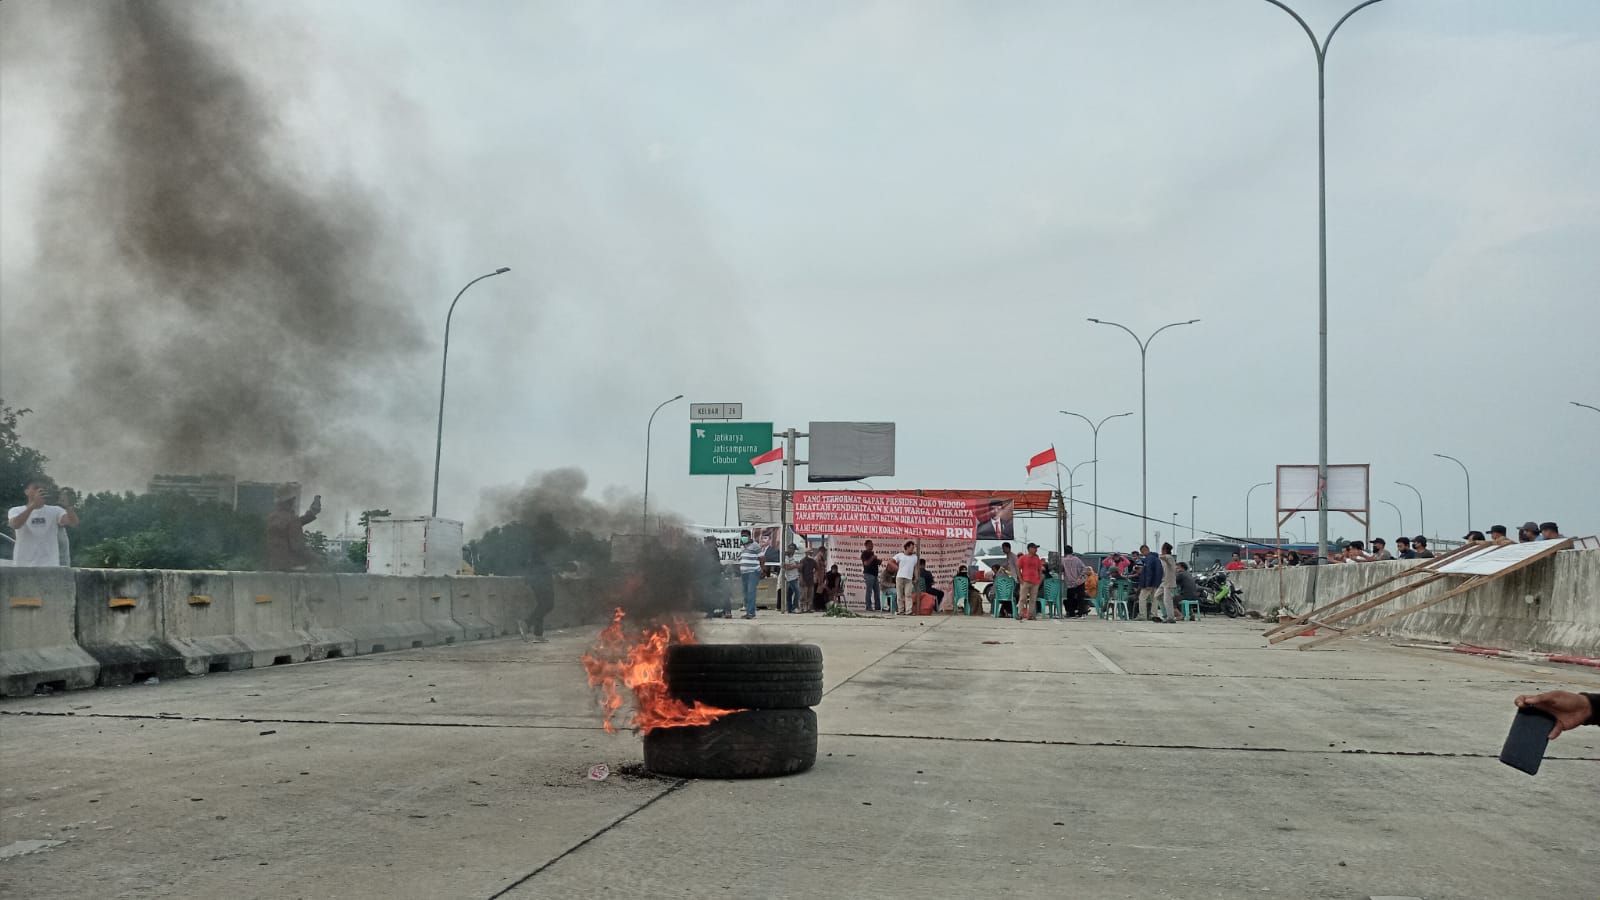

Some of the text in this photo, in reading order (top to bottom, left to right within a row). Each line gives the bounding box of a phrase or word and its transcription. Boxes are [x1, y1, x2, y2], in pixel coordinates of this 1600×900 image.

[713, 434, 743, 443] Jatikarya
[712, 445, 758, 454] Jatisampurna
[712, 456, 737, 464] Cibubur
[803, 495, 966, 509] YANG TERHORMAT BAPAK PRESIDEN JOKO WIDODO
[795, 503, 974, 518] LIHATLAH PENDERITAAN KAMI WARGA JATIKARYA
[795, 512, 974, 526] TANAH PROYEK JALAN TOL INI BELUM DIBAYAR GANTI RUGINYA
[795, 524, 811, 532] KAMI
[811, 524, 835, 532] PEMILIK
[835, 525, 847, 533] SAH
[848, 525, 870, 533] TANAH
[870, 525, 878, 533] INI
[878, 526, 903, 535] KORBAN
[904, 527, 922, 535] MAFIA
[923, 528, 945, 536] TANAH
[945, 528, 974, 538] BPN
